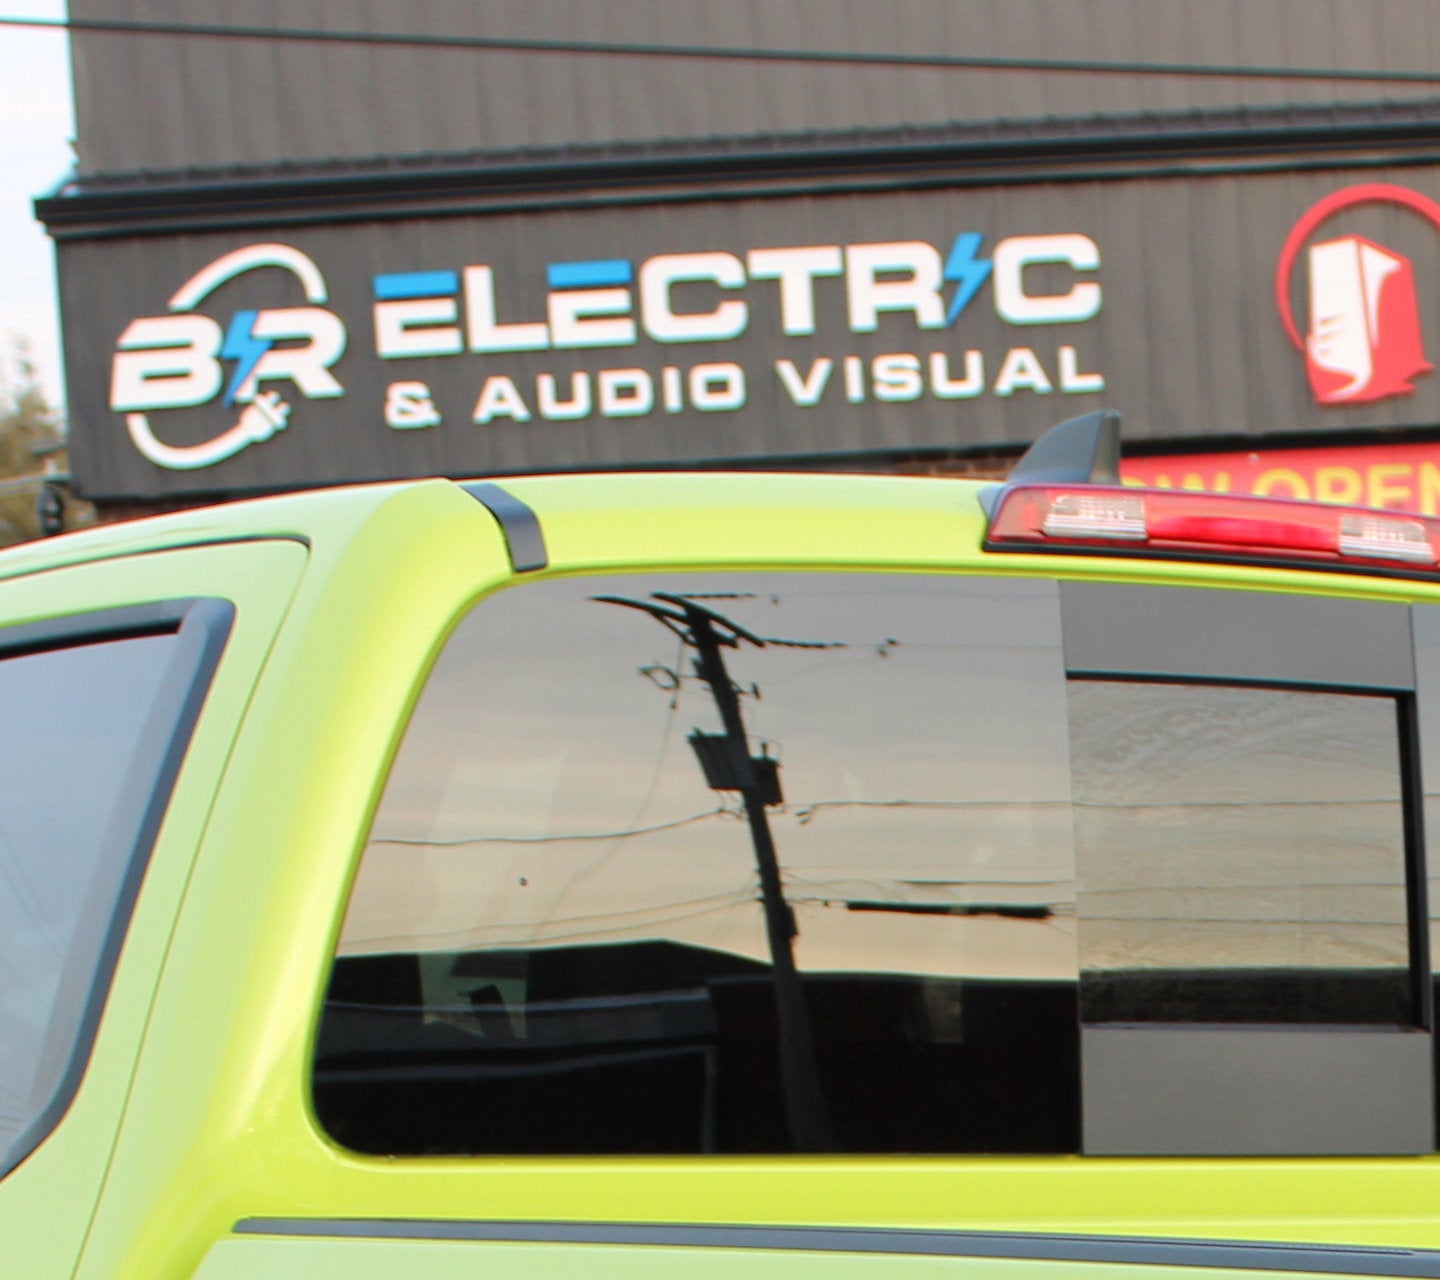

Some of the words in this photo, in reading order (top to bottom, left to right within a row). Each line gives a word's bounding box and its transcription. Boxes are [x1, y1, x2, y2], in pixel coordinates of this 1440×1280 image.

[374, 233, 1100, 357] ELECTRIC
[385, 382, 440, 428] &
[473, 361, 745, 424] AUDIO
[776, 346, 1104, 404] VISUAL
